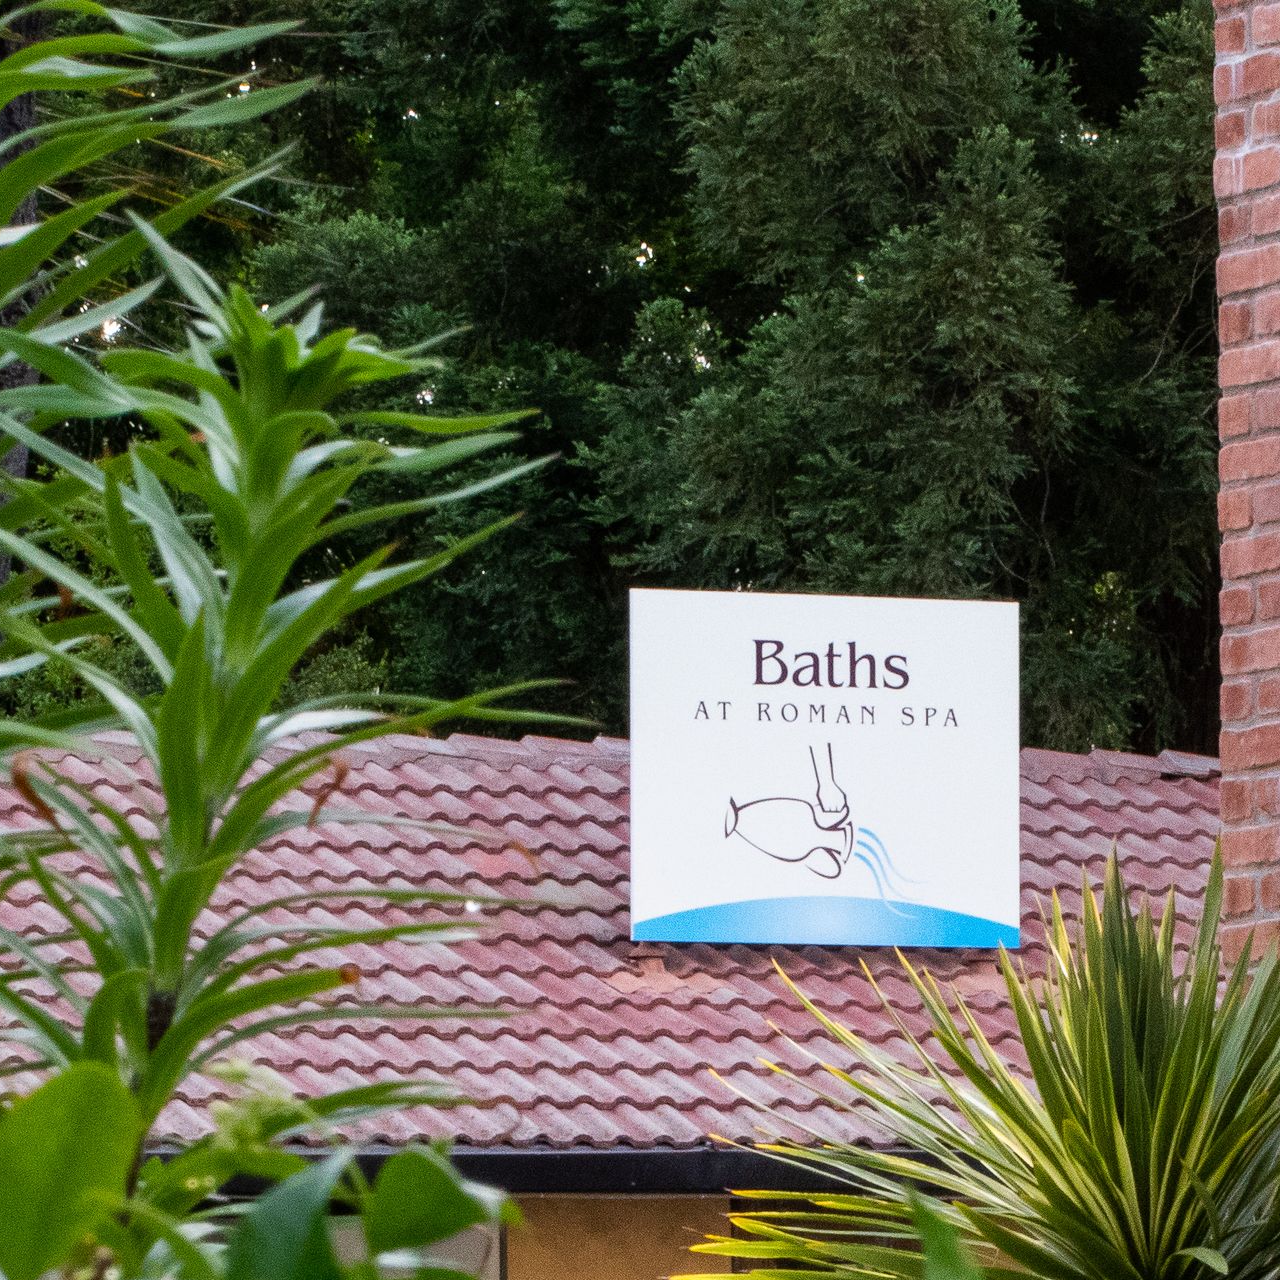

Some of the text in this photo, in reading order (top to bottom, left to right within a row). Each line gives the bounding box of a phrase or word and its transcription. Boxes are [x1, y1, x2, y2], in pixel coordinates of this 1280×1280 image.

[753, 639, 910, 690] Baths
[694, 700, 959, 728] AT ROMAN SPA
